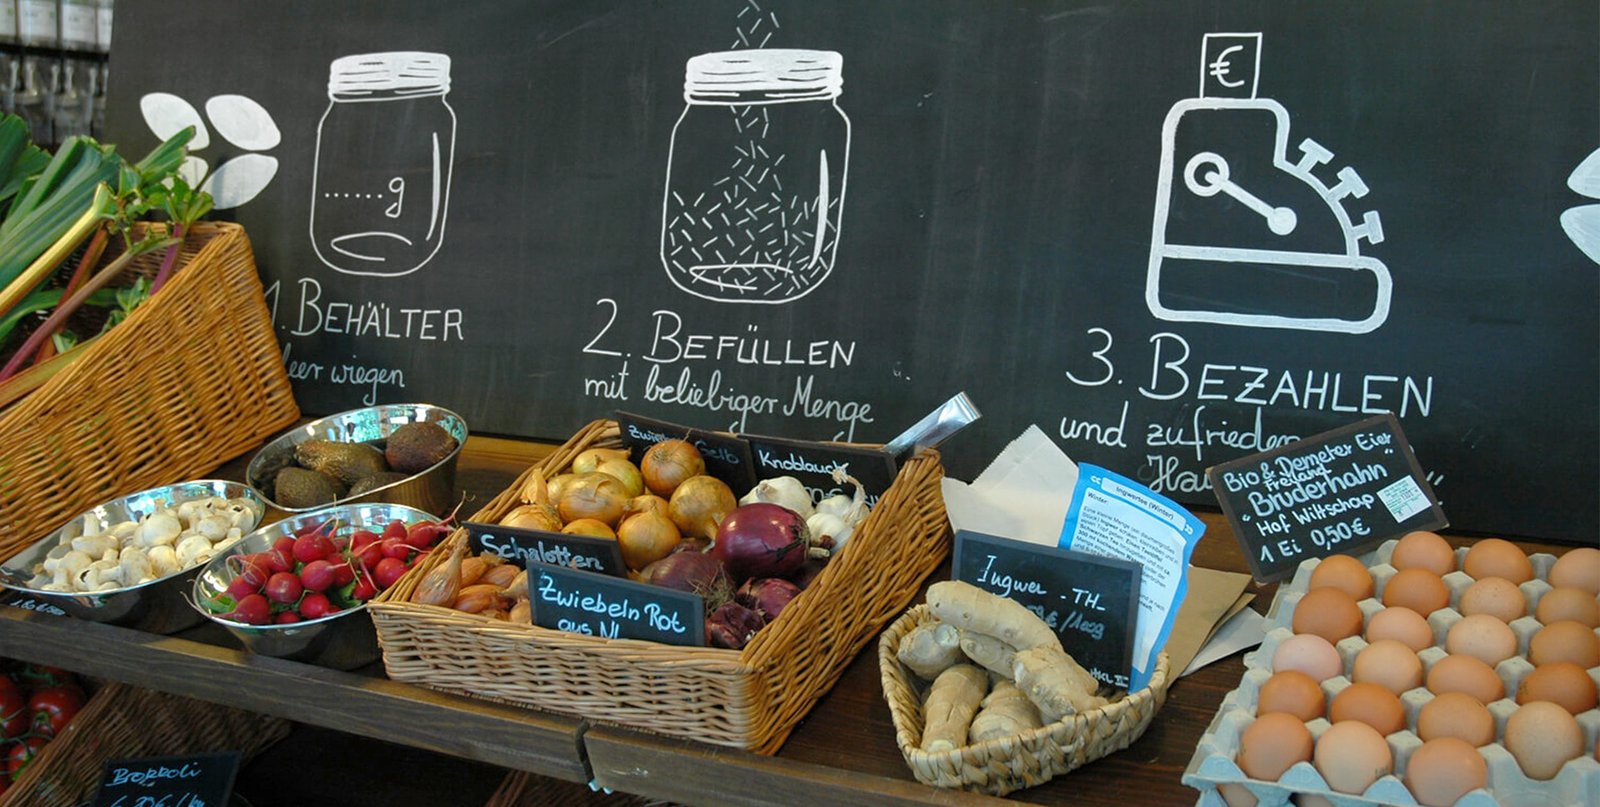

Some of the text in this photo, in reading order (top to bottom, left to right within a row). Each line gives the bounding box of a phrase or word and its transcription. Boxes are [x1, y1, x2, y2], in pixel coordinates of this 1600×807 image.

[290, 277, 464, 342] BEHÄLTER
[582, 298, 856, 369] 2. BEFÜLLEN
[330, 353, 406, 407] wiegen
[1065, 327, 1434, 418] 3. BEZAHLEN
[584, 361, 875, 443] mit beliebiger Menge
[1060, 400, 1128, 448] und
[1223, 431, 1392, 493] Bio & Demeter Eier
[480, 533, 604, 570] Schalotten
[1256, 514, 1292, 537] Hof
[1260, 545, 1274, 563] 1
[1277, 538, 1303, 557] Ei
[539, 575, 686, 634] Zwiebeln Rot
[977, 555, 1047, 598] Ingwer
